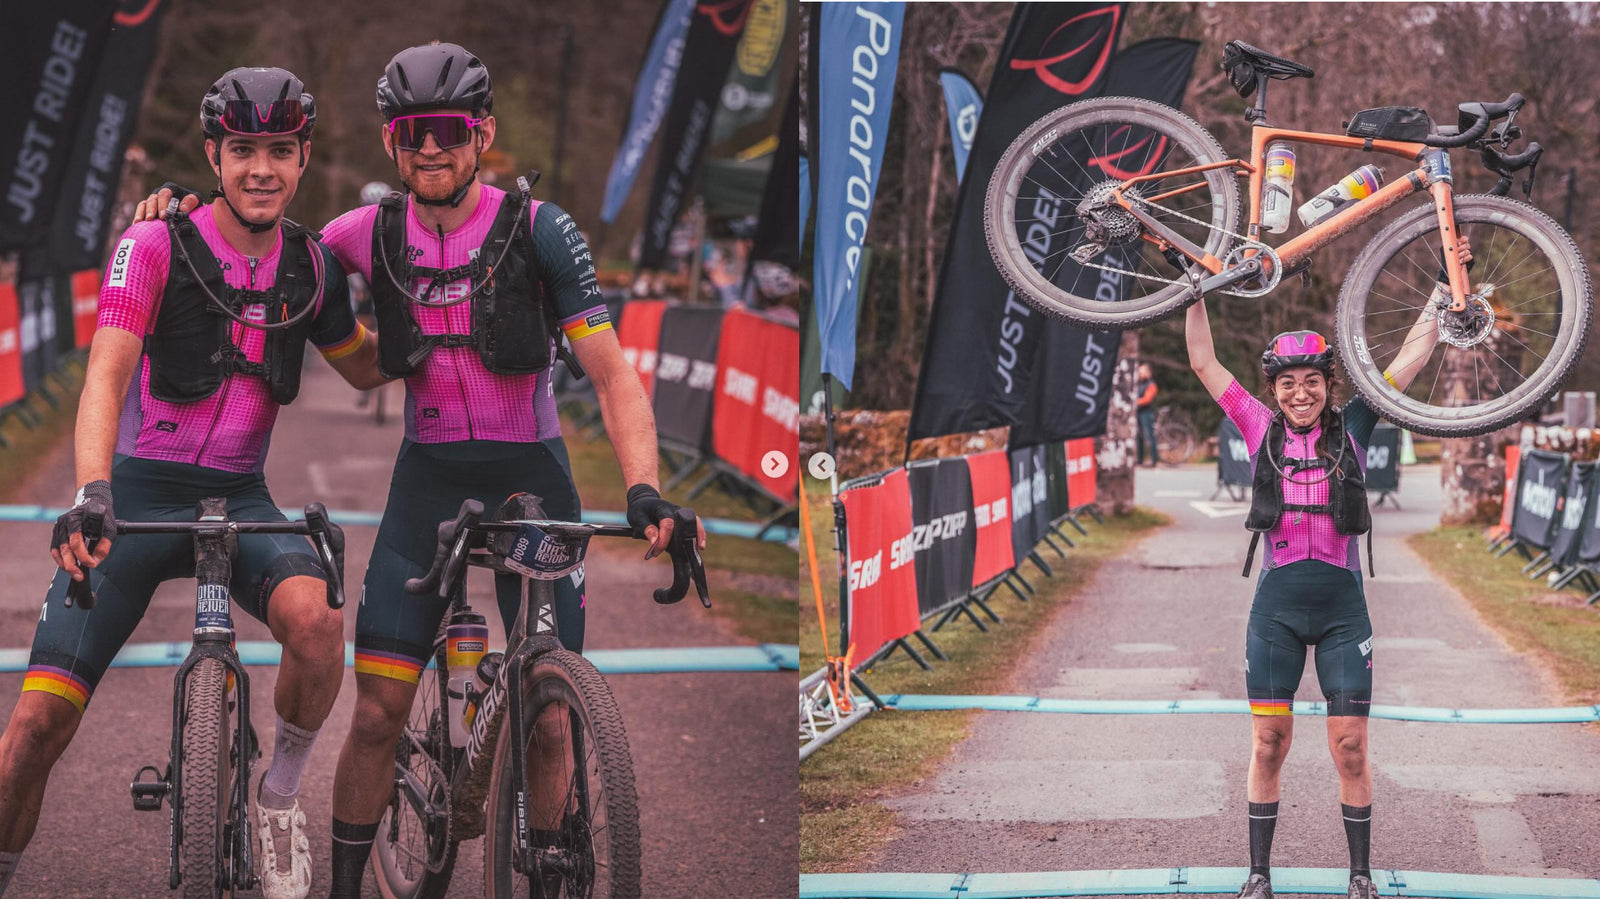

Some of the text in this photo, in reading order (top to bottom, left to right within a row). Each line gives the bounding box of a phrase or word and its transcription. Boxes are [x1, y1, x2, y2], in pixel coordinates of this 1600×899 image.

[7, 20, 87, 223] JUST RIDE!
[75, 93, 127, 250] JUST RIDE!
[845, 6, 892, 290] Panarace
[113, 245, 129, 280] LE COL
[997, 187, 1062, 393] JUST IDE!
[1075, 254, 1123, 415] JUST DE!
[513, 538, 529, 561] 0089
[942, 511, 967, 540] ZIPP
[198, 585, 229, 600] DIRTY
[517, 792, 527, 848] RIBBLE
